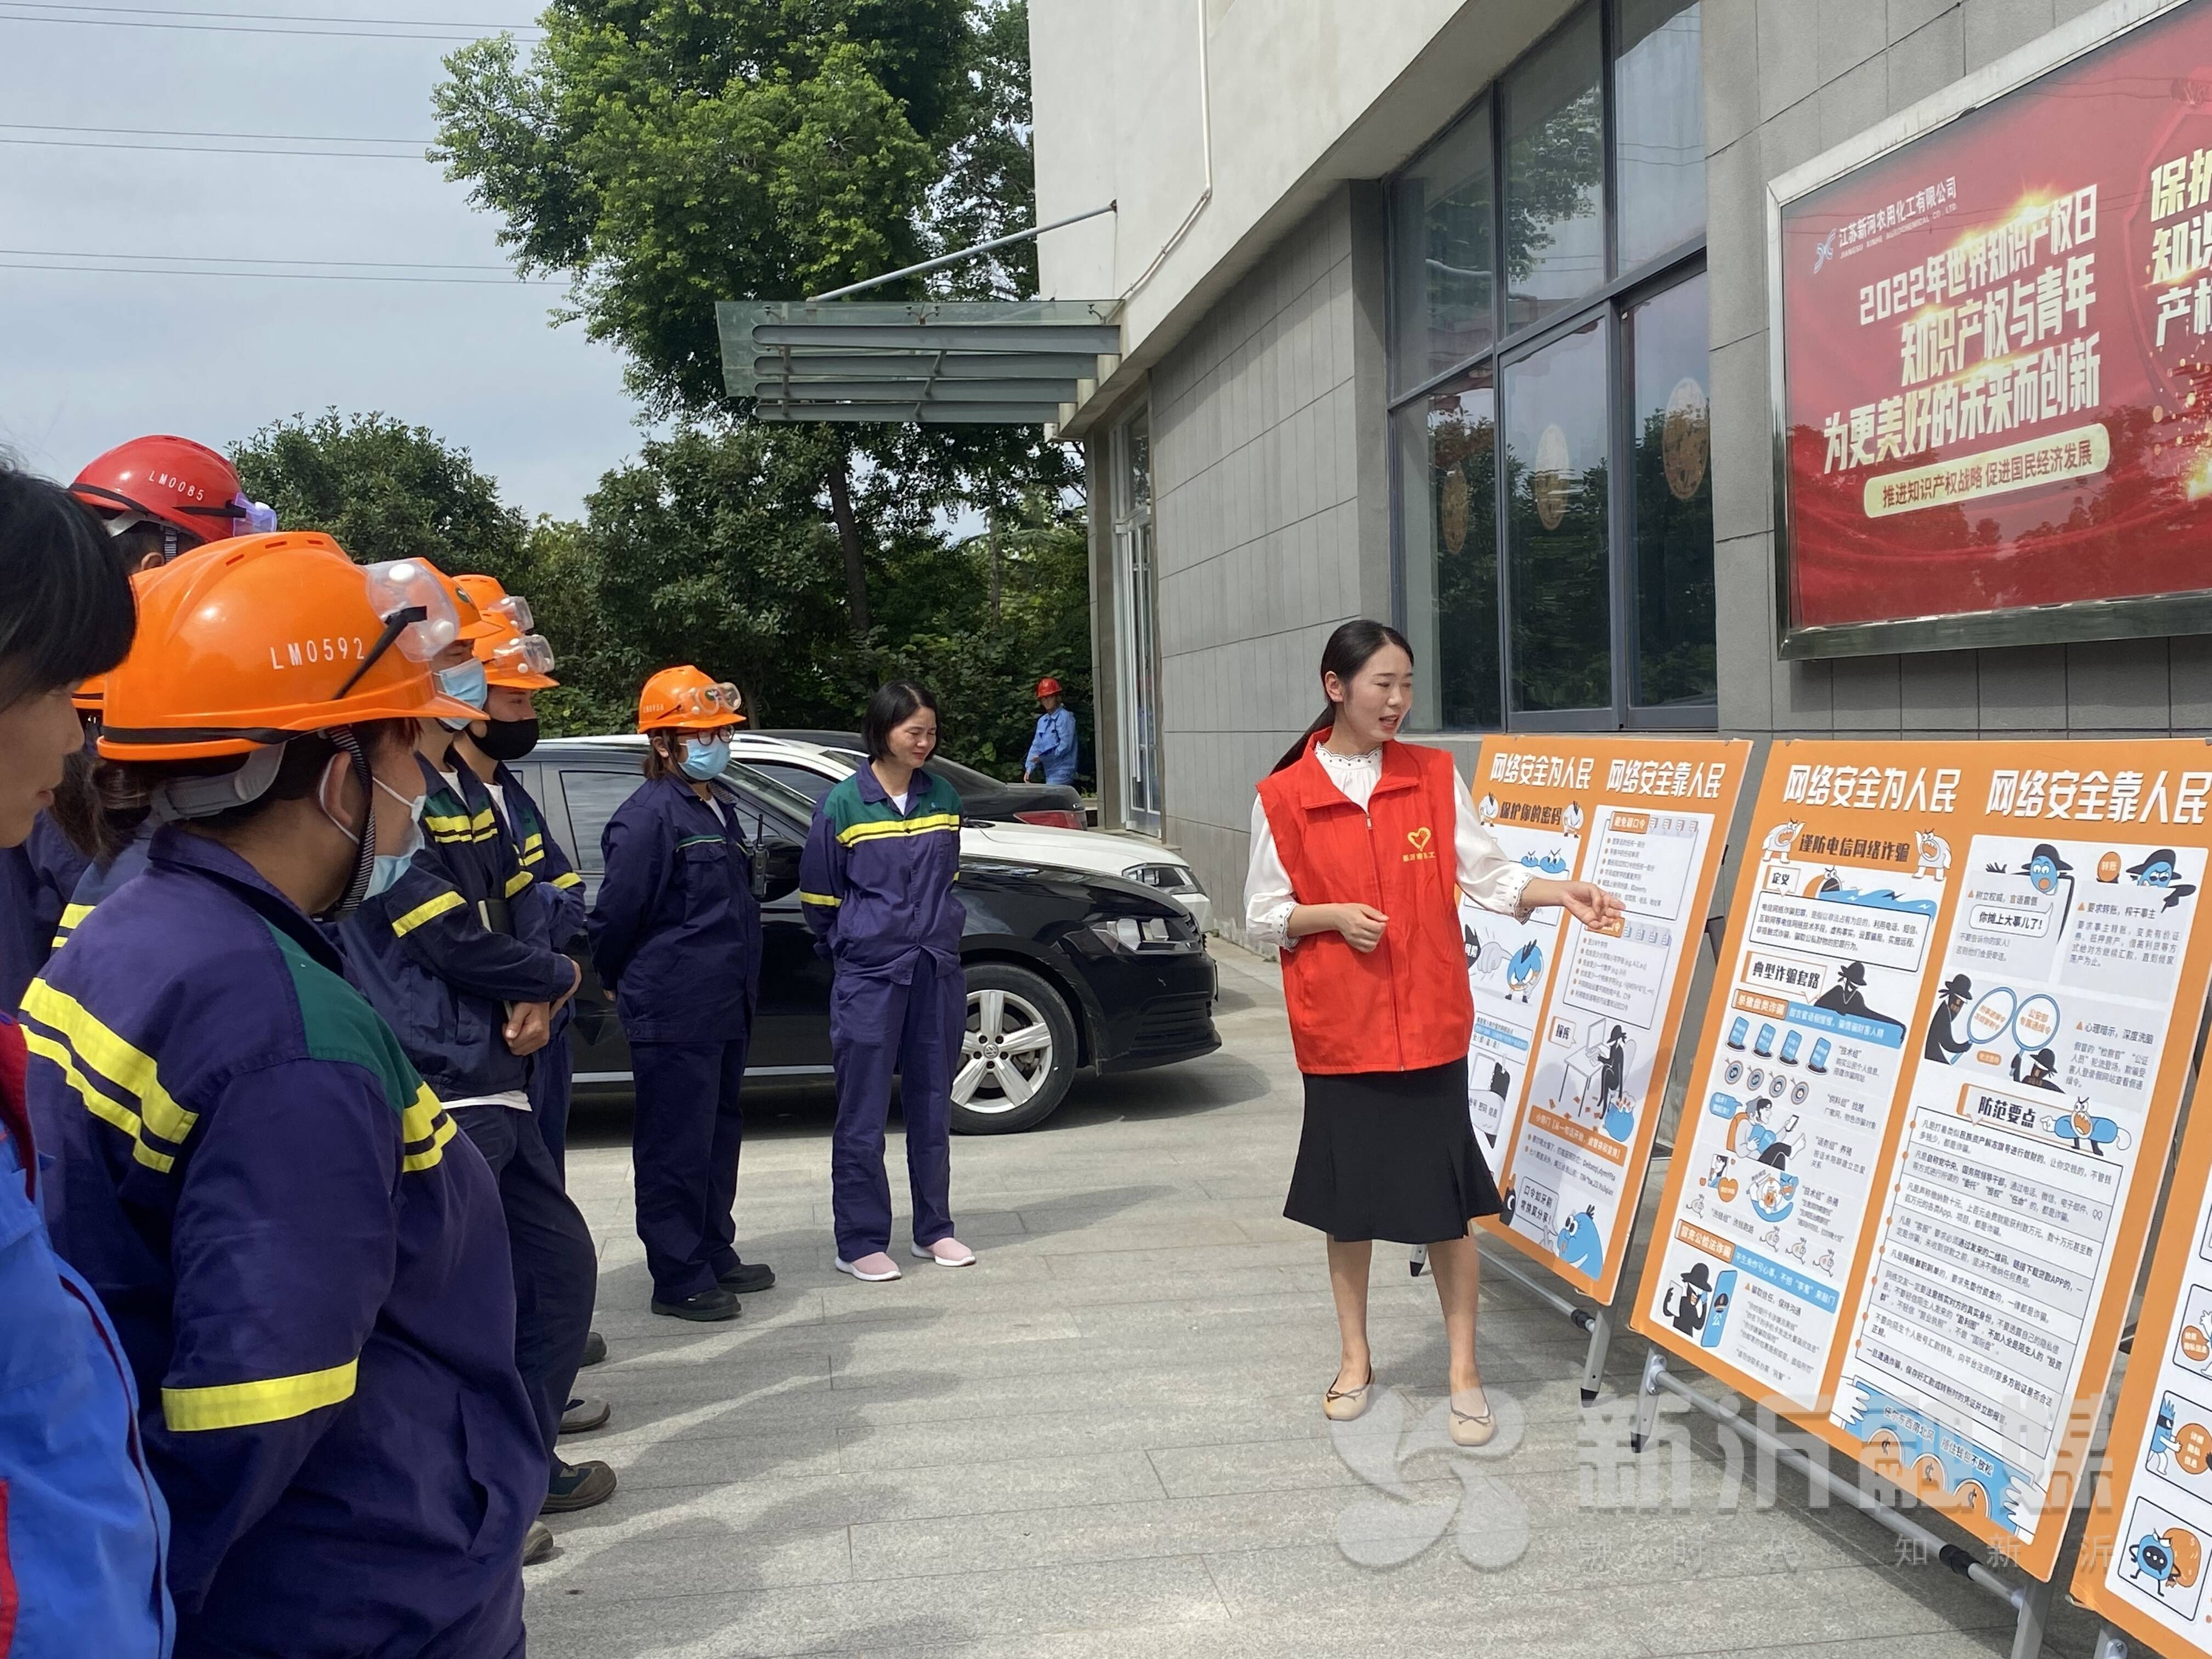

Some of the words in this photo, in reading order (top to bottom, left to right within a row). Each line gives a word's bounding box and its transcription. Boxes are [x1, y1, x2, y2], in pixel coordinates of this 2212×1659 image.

[1839, 176, 1956, 247] 江苏新河农用化工有限公司
[1841, 244, 1864, 259] JIANGSU
[1866, 235, 1883, 248] XINHE
[1886, 215, 1929, 239] AGROCHEMICAL
[1860, 184, 2097, 325] 2022年世界知识产权日
[1901, 253, 2096, 387] 知识产权与青年
[1824, 332, 2101, 474] 为更美好的未来而创新
[148, 469, 205, 502] LM0085
[1883, 467, 1983, 509] 推进知识产权战略
[1985, 441, 2092, 488] 促进国民经济发展
[271, 637, 366, 670] LM0592
[1489, 753, 1595, 790] 网络安全为人民
[1606, 758, 1726, 799] 网络安全靠人民
[1782, 765, 1961, 812] 网络安全为人民
[1985, 770, 2212, 823] 网络安全靠人民
[1499, 802, 1561, 825] 保护你的密码
[1799, 833, 1910, 862] 谨防电信网络诈骗
[1770, 872, 1790, 885] 定义
[1752, 961, 1821, 989] 典型诈骗套路
[1977, 1094, 2037, 1128] 防范要点
[1680, 1224, 1732, 1259] 冒充公检法诈骗
